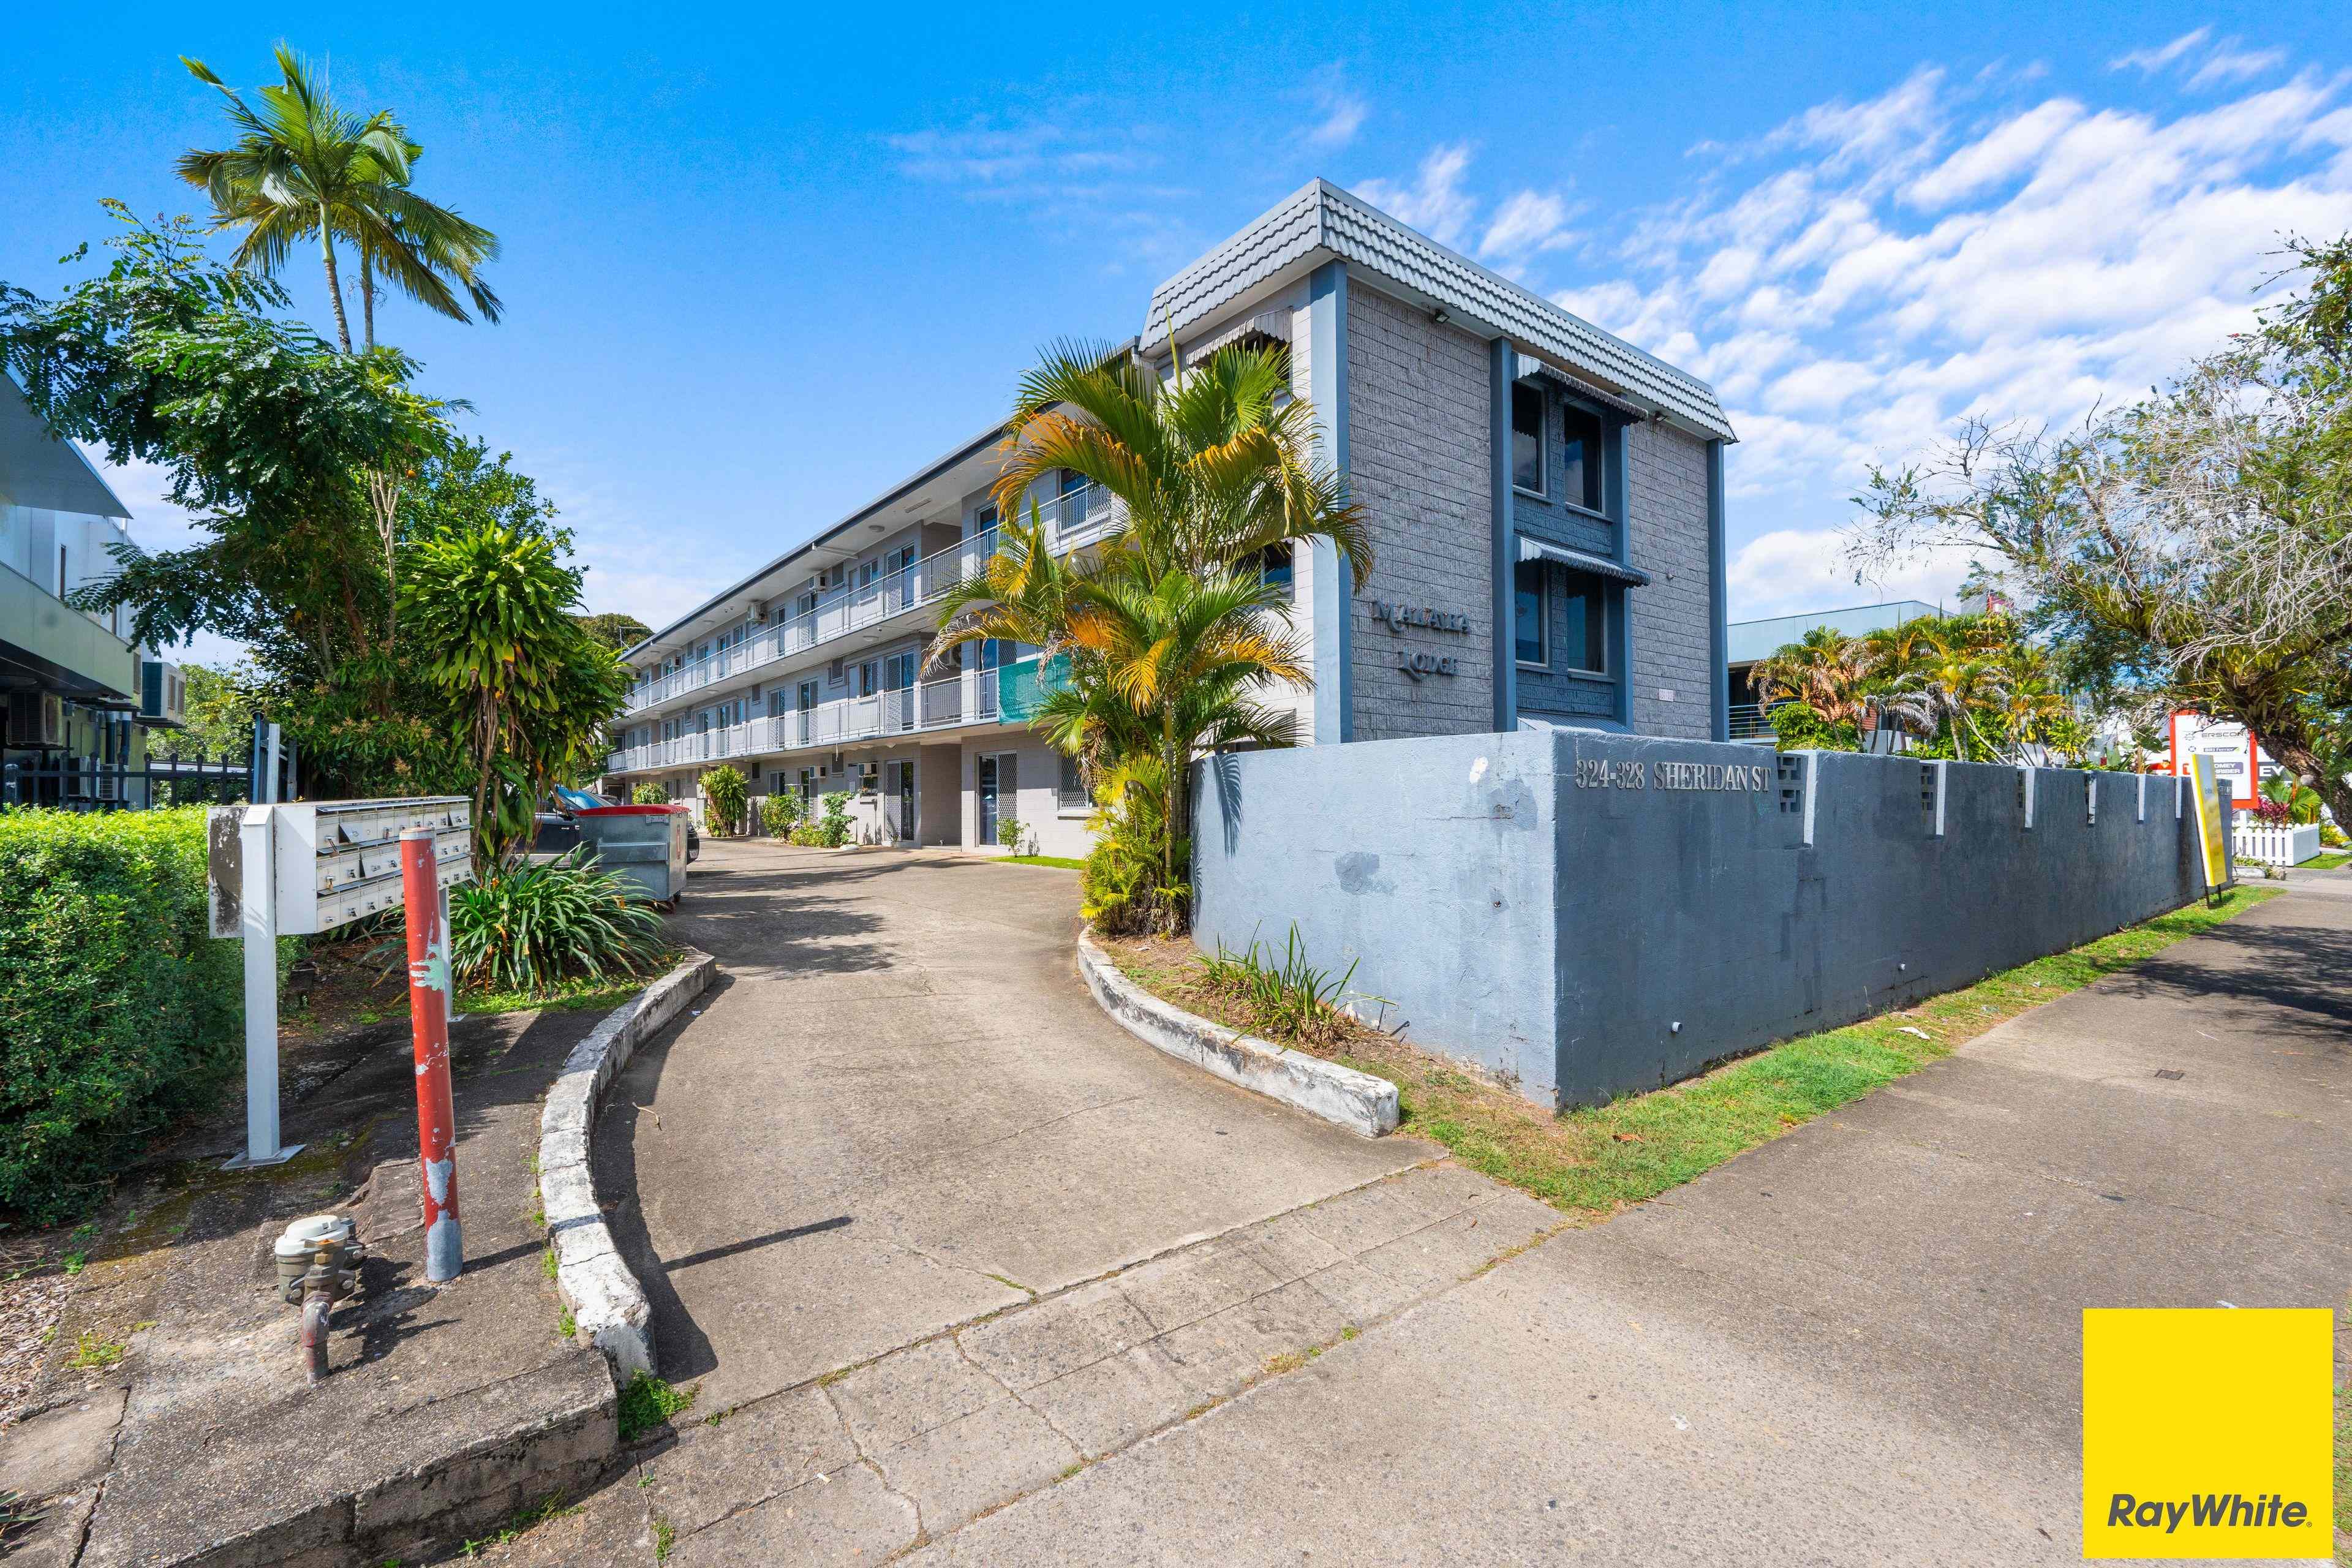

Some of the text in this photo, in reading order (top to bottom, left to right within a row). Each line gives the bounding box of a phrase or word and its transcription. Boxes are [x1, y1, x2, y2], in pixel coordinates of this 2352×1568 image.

[1576, 760, 1771, 793] 324-328 SHERIDAN ST
